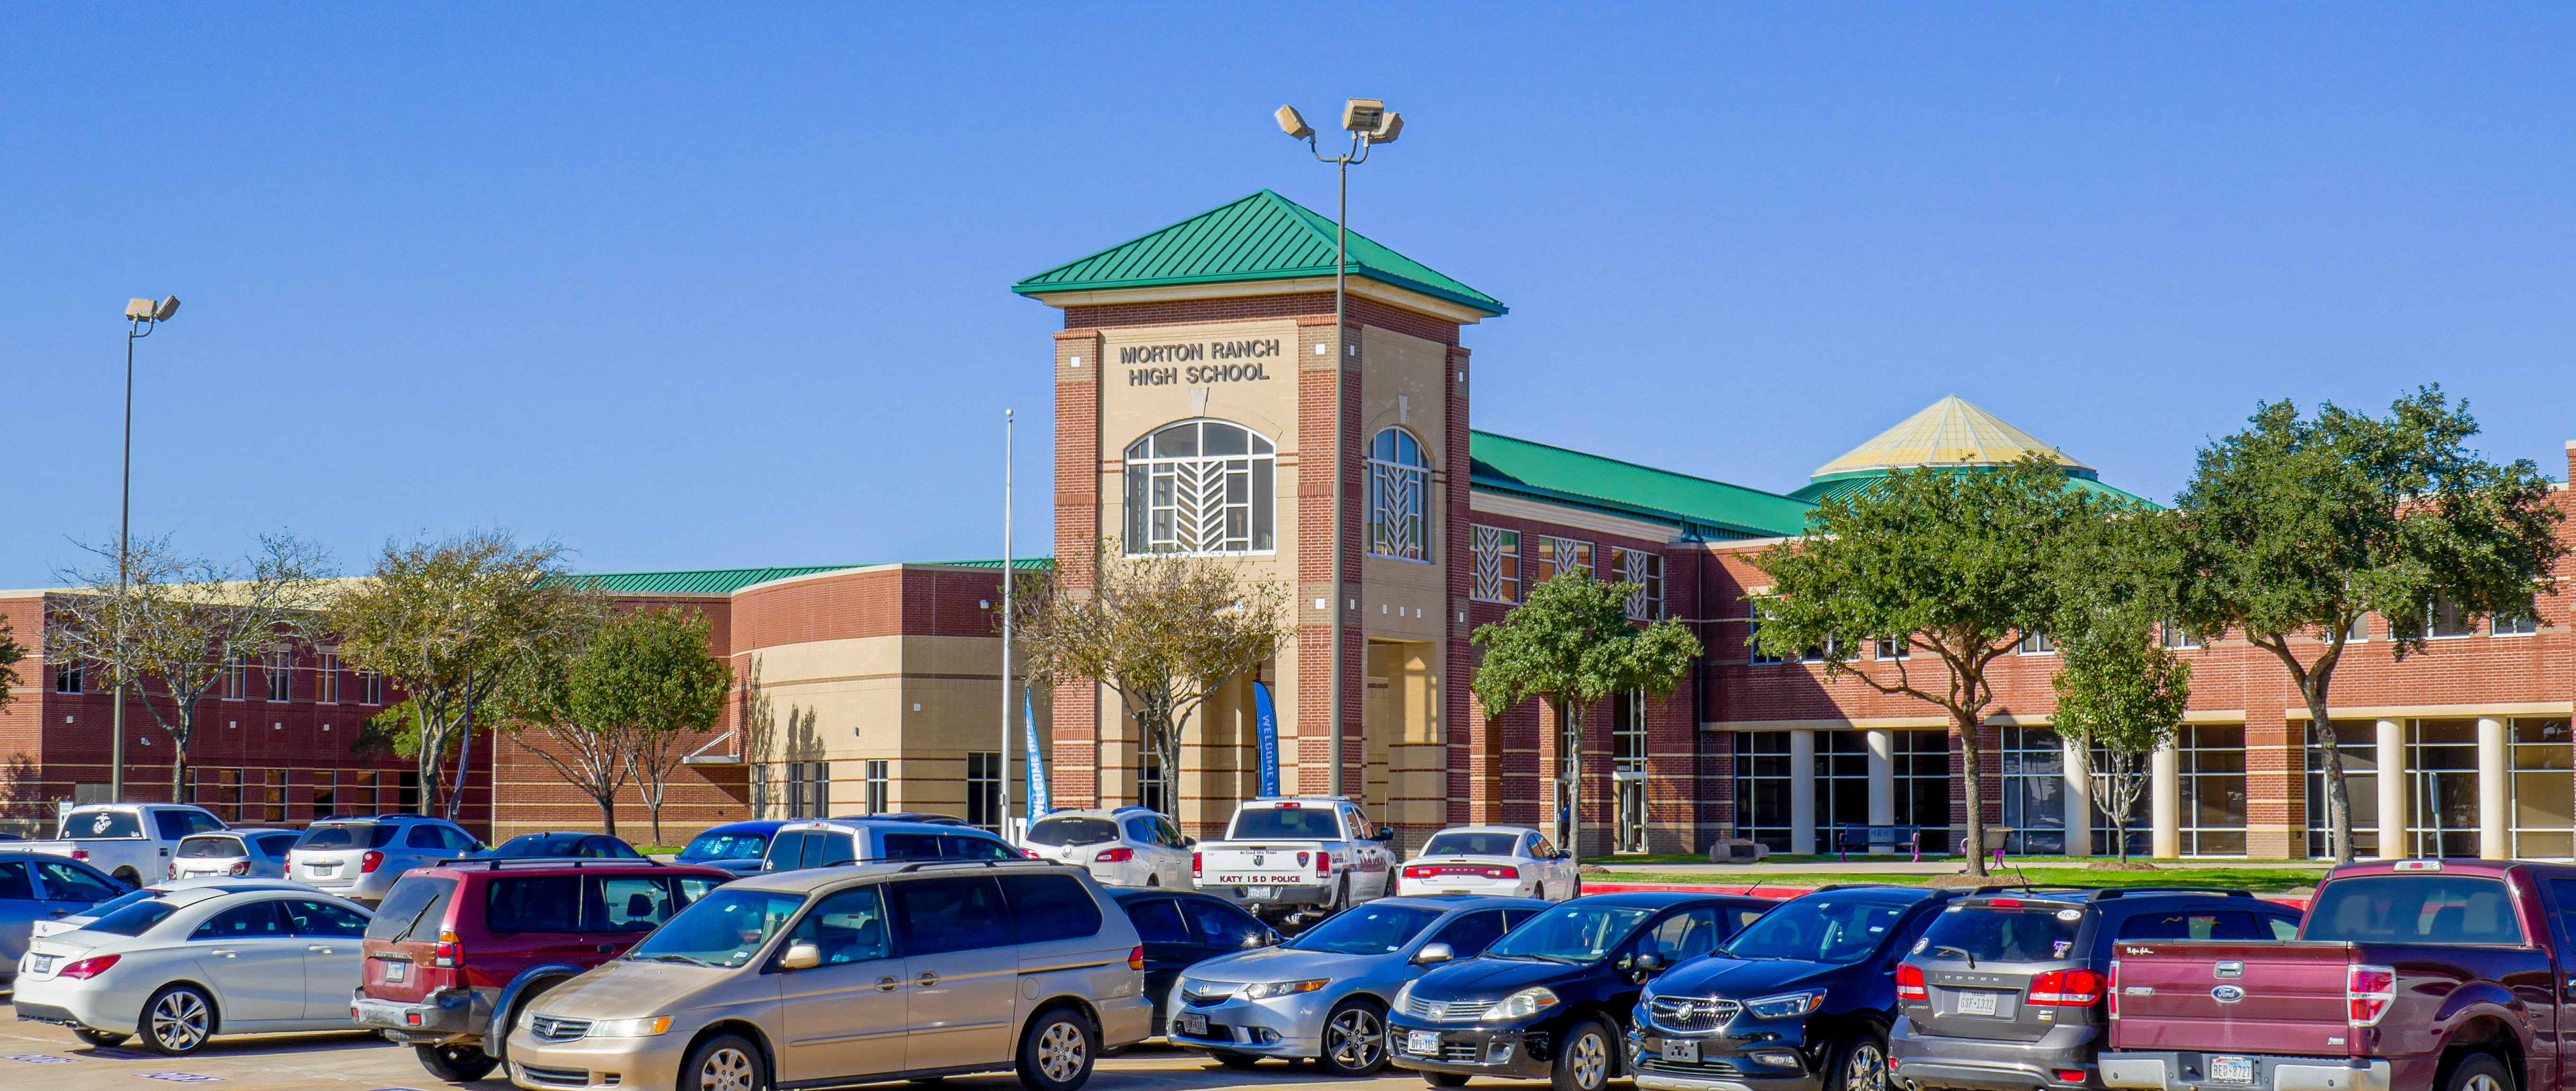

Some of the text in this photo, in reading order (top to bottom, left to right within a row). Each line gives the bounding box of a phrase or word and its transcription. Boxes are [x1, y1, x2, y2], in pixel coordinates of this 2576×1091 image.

[1120, 339, 1279, 364] MORTON RANCH
[1129, 363, 1270, 386] HIGH SCHOOL
[1262, 714, 1273, 778] WELCOME
[1030, 755, 1046, 817] WELCOME
[2217, 987, 2236, 998] Ford
